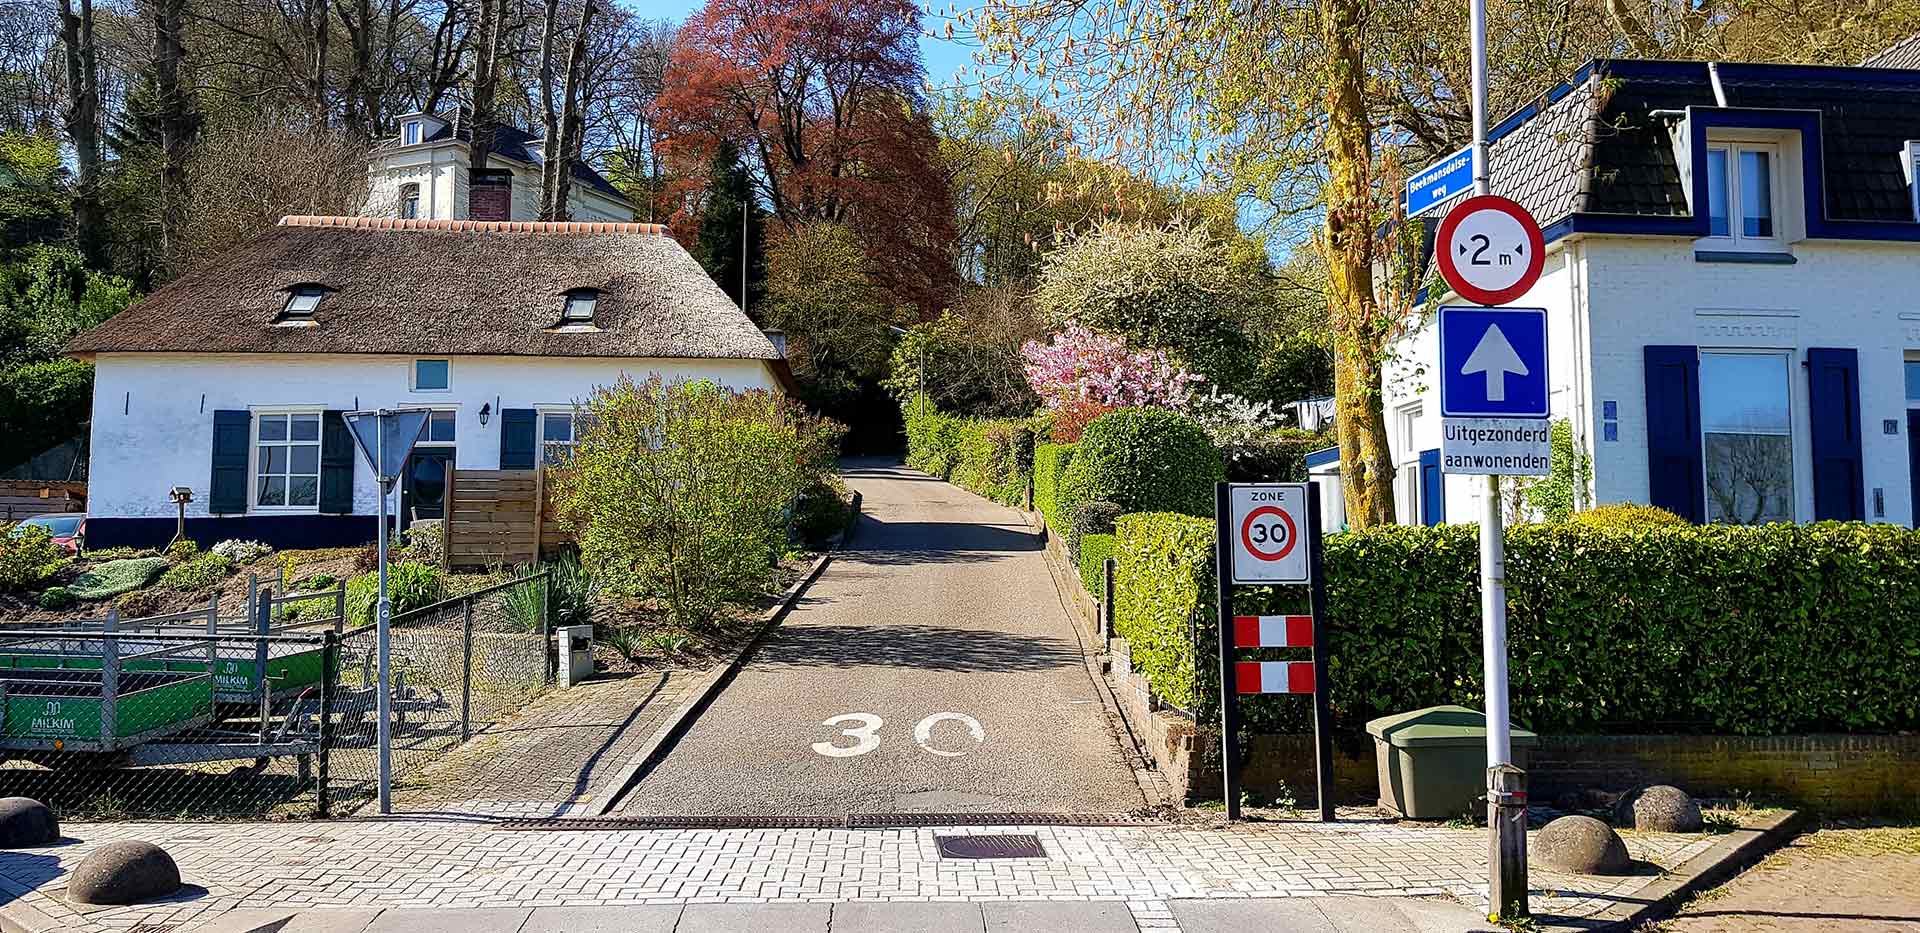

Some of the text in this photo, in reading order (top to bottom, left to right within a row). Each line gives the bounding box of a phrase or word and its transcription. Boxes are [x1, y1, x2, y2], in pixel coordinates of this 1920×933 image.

[1409, 157, 1470, 194] Beekmansdalse-
[1431, 184, 1447, 199] weg
[1470, 233, 1512, 266] 2 m
[1445, 425, 1547, 446] Uitgezonderd
[1445, 453, 1548, 469] aanwonenden
[1251, 492, 1285, 501] ZONE
[1252, 523, 1286, 543] 30
[31, 718, 75, 729] MILKIM
